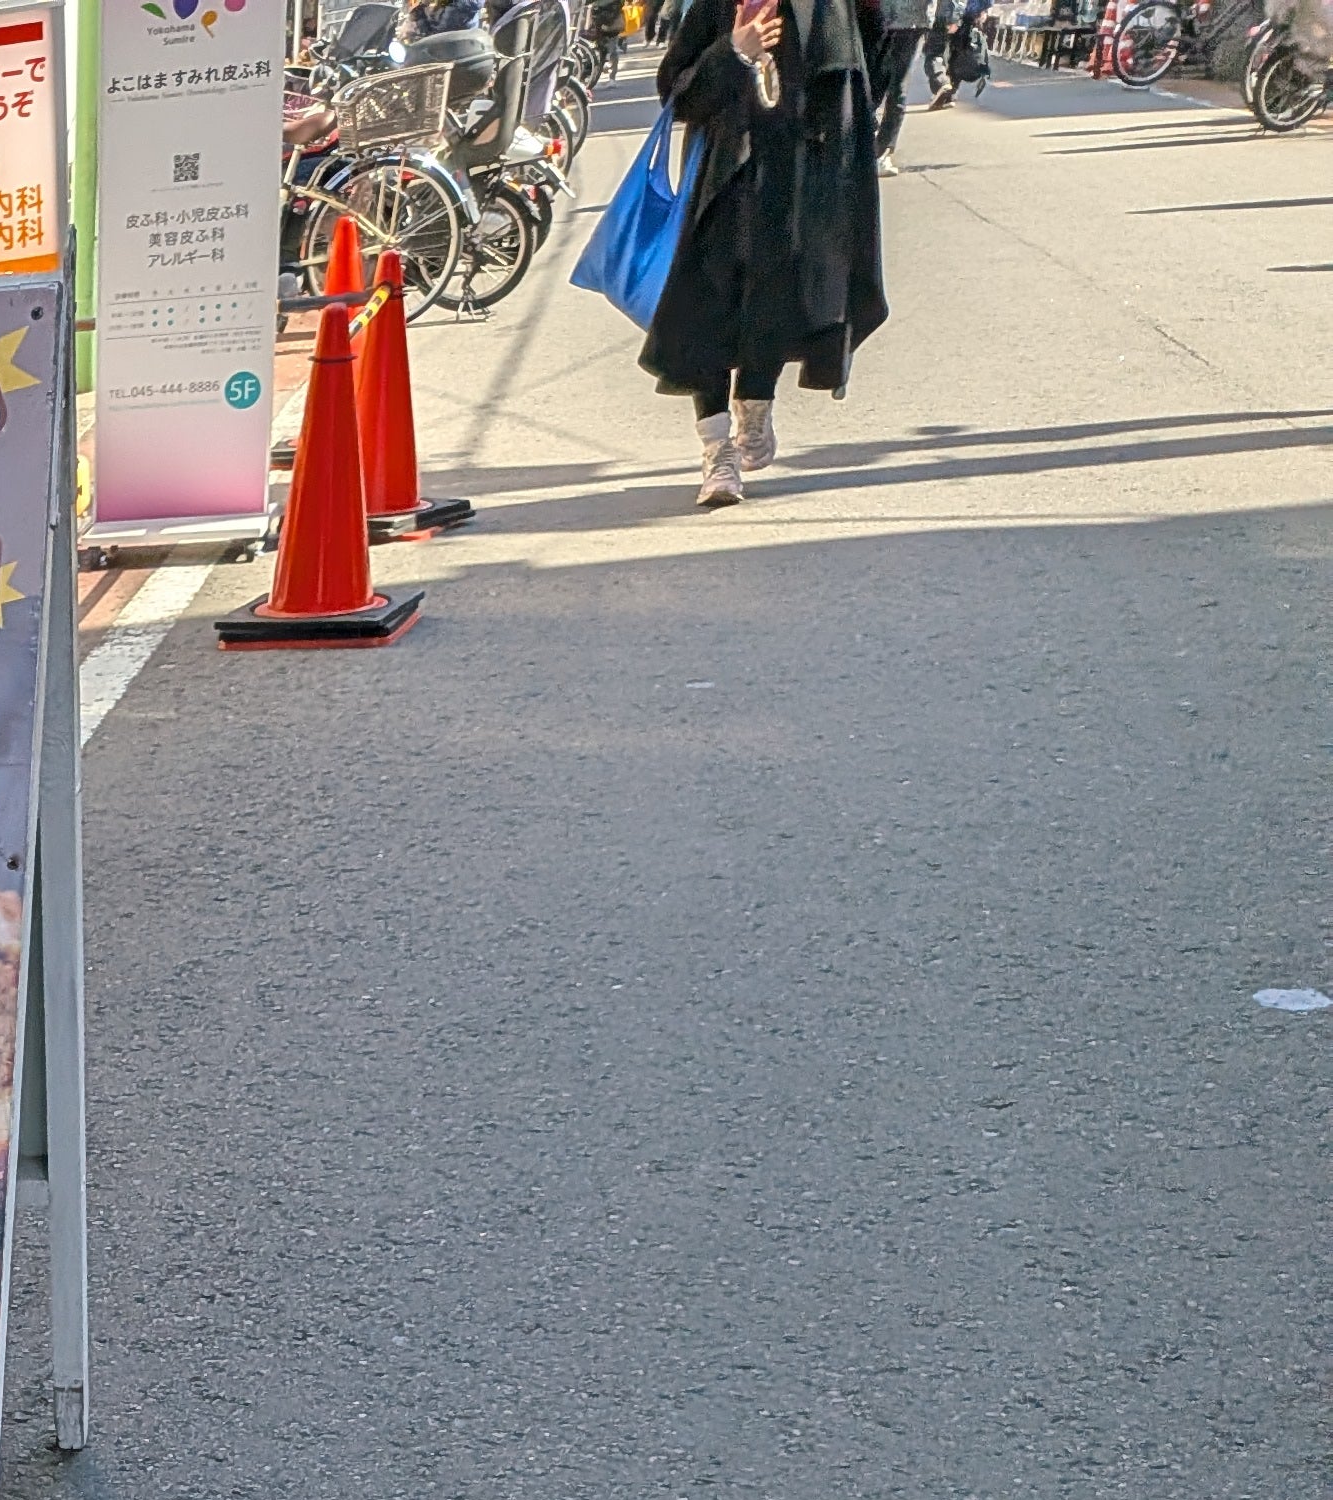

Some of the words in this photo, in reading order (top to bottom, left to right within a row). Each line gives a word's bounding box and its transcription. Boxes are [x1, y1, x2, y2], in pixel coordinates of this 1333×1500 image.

[146, 23, 196, 36] Yokohama
[162, 36, 196, 46] Sumire
[148, 248, 225, 268] アレルギー科
[229, 379, 257, 402] 5F
